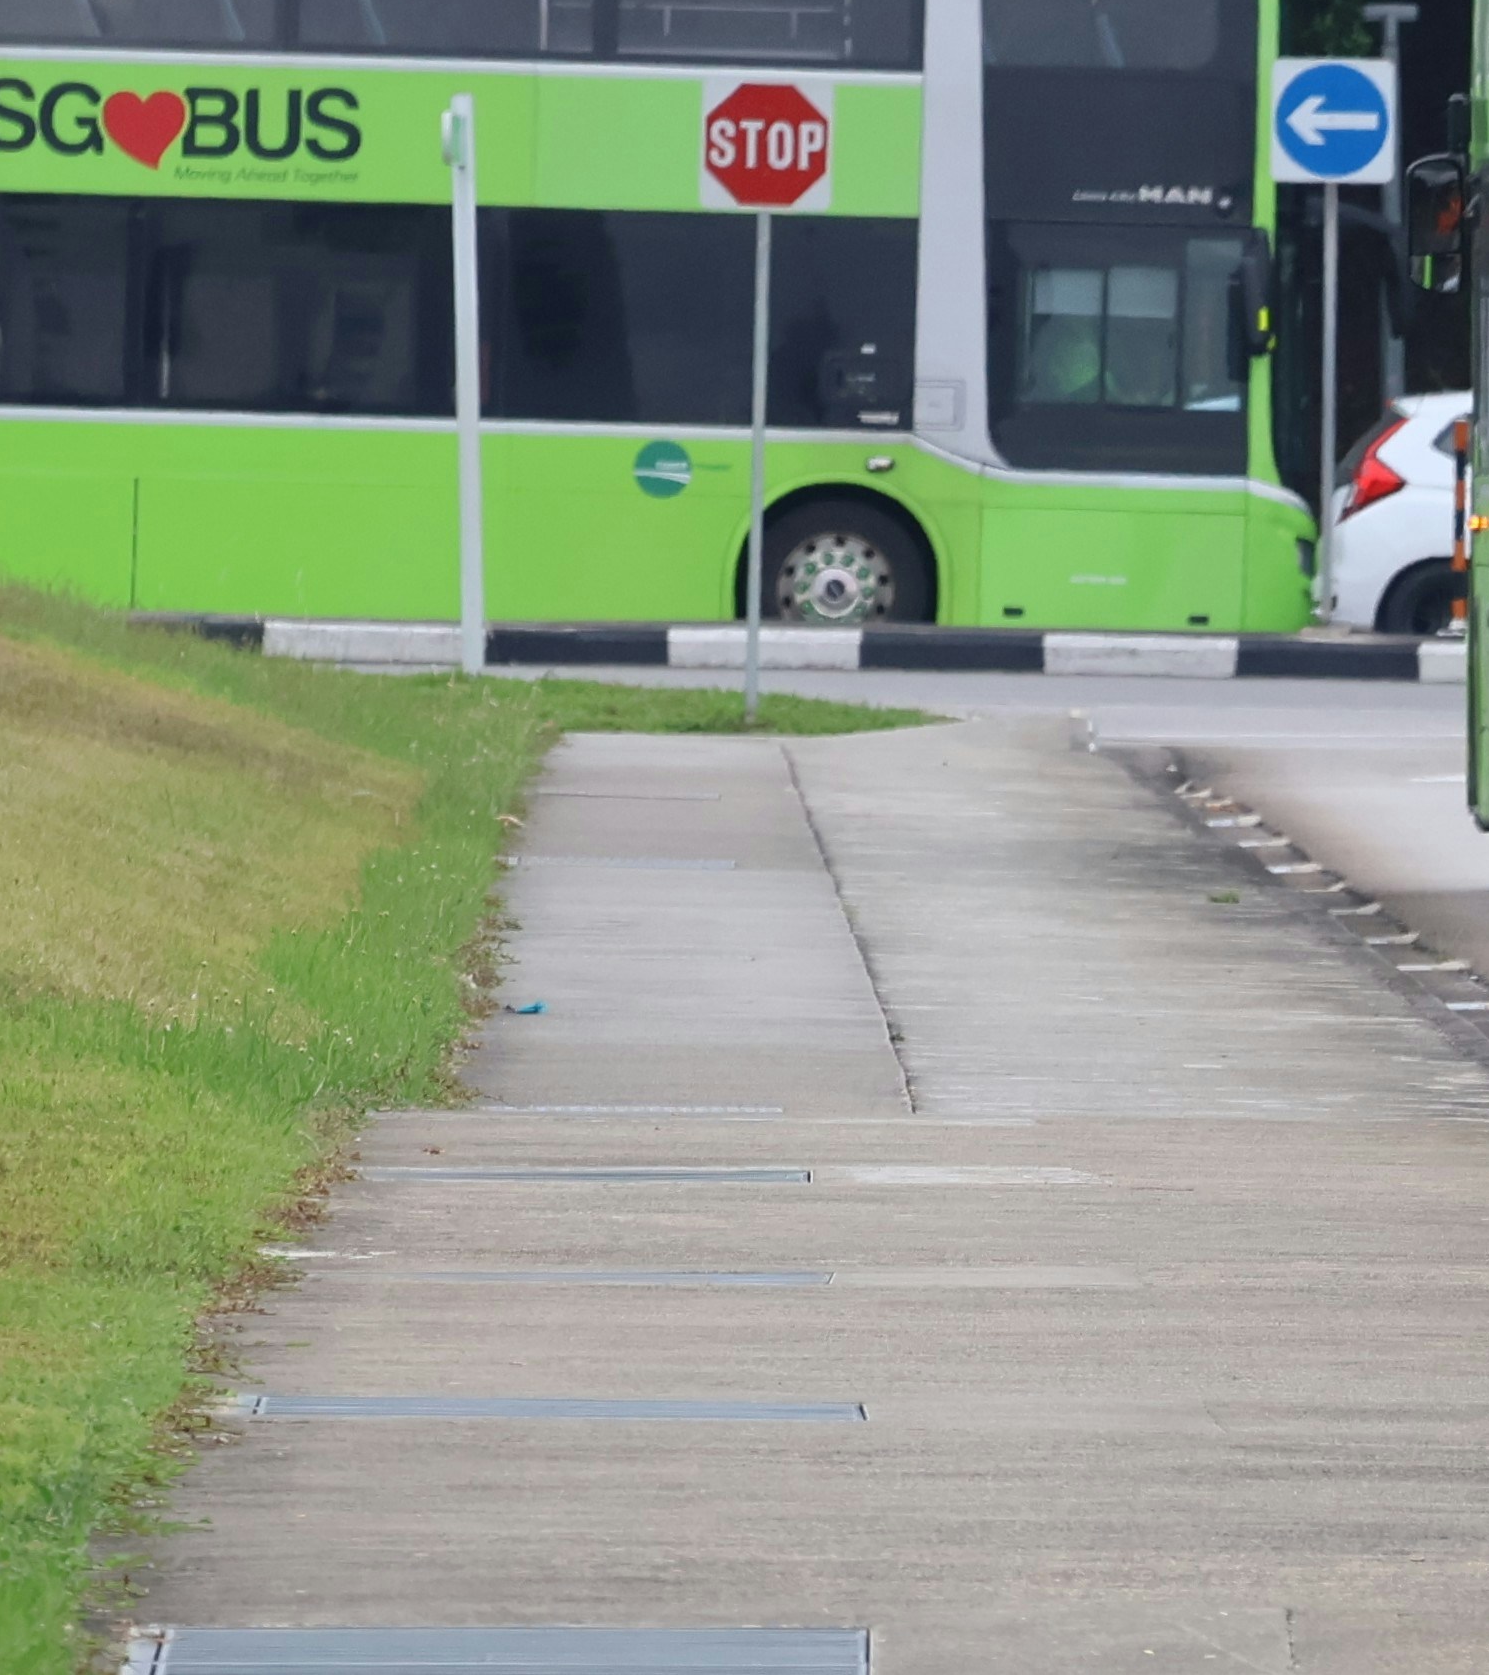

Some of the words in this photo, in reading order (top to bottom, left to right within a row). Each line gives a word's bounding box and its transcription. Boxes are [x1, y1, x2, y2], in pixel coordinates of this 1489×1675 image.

[181, 86, 362, 164] BUS
[708, 117, 826, 172] STOP
[174, 166, 232, 185] Moving
[235, 167, 289, 183] Ahead
[294, 167, 360, 186] Together
[1138, 184, 1214, 206] MAN
